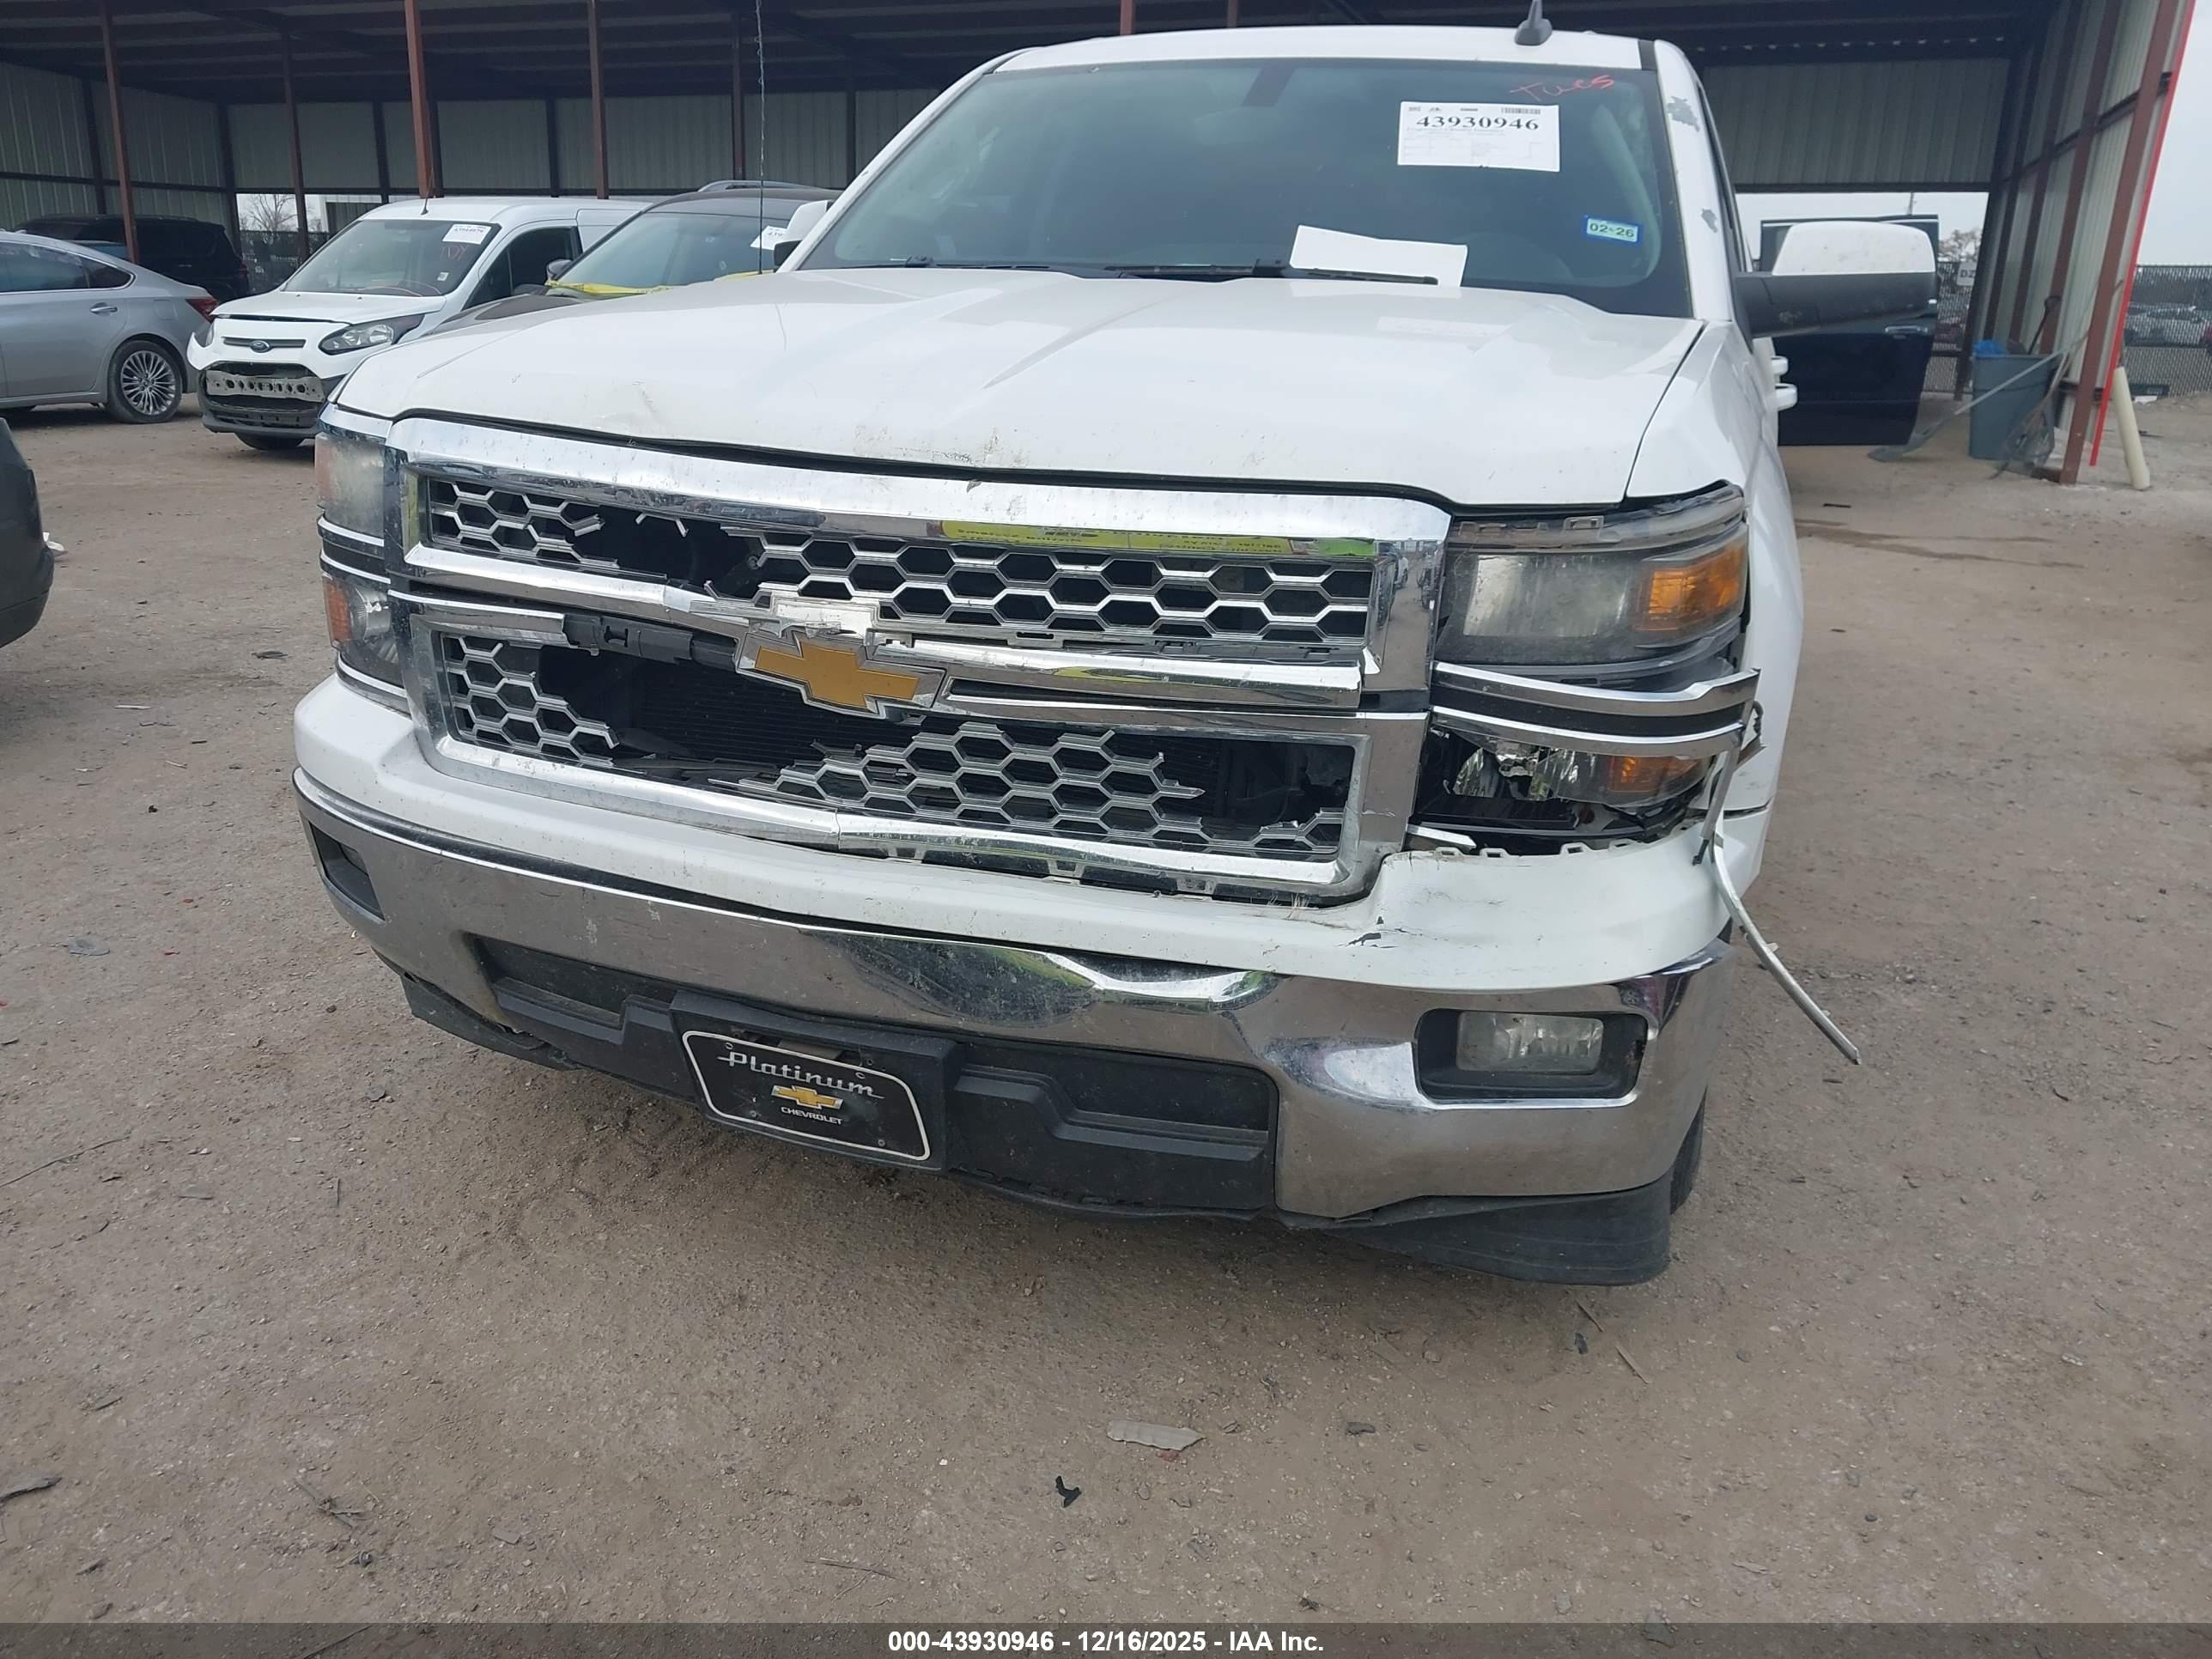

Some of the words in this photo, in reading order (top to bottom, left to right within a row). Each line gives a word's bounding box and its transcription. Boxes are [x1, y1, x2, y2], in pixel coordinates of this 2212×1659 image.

[1416, 115, 1540, 131] 43930946
[716, 1050, 885, 1100] Platinum
[781, 1107, 842, 1125] CHEVROLET
